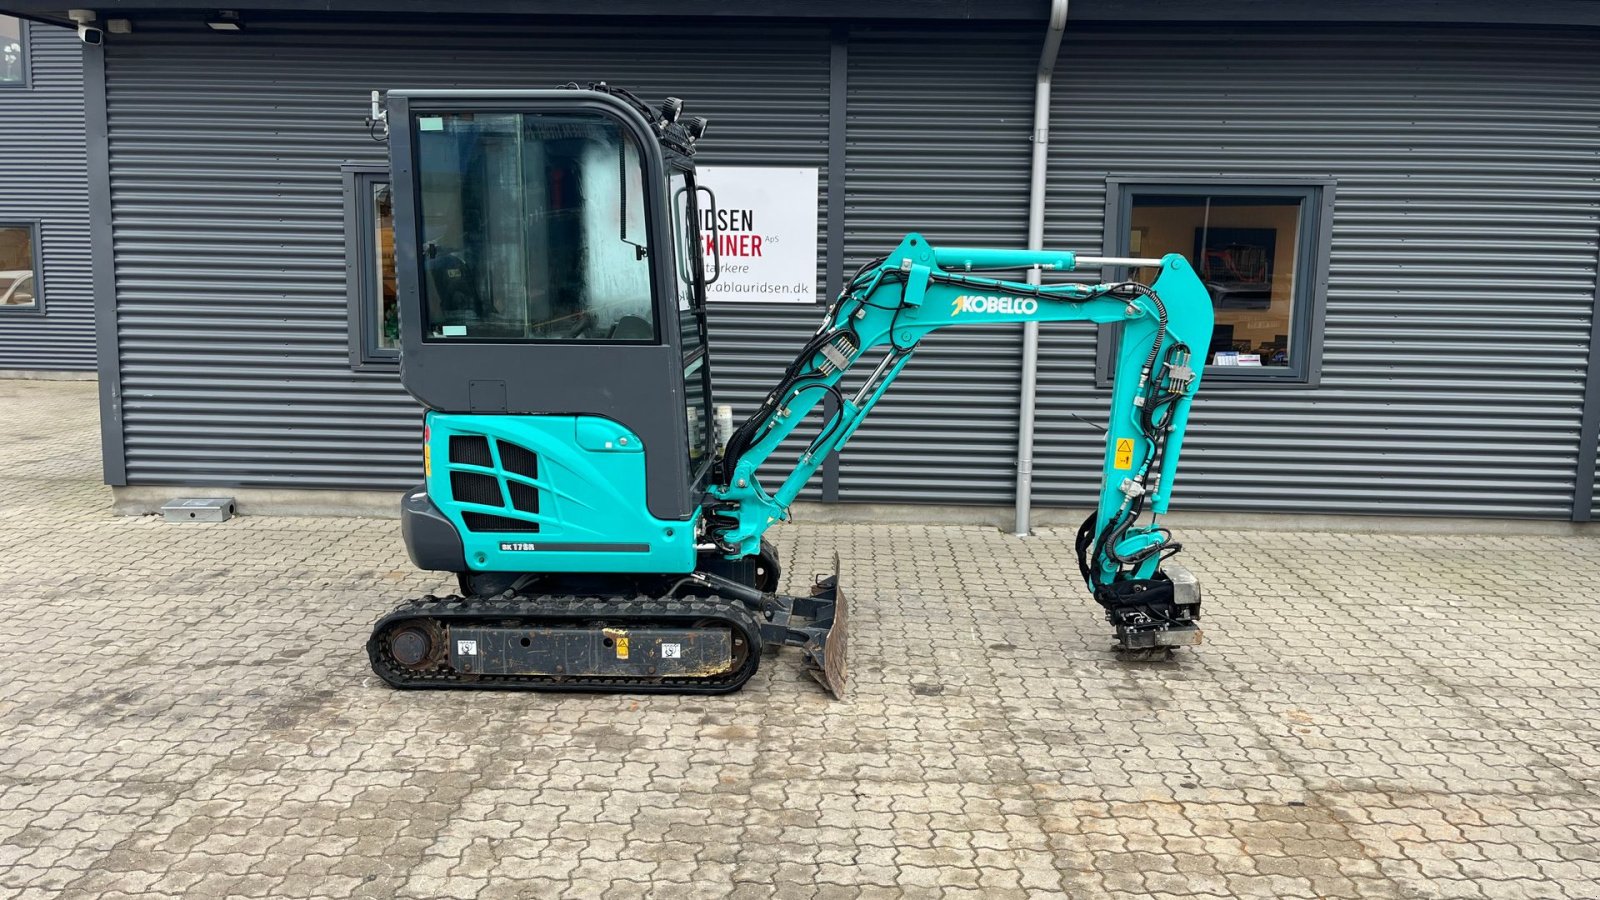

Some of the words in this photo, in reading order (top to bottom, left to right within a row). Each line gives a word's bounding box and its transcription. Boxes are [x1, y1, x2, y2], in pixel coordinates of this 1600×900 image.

[701, 234, 762, 256] KINER
[765, 235, 780, 243] ApS
[962, 295, 1039, 315] KOBELCO
